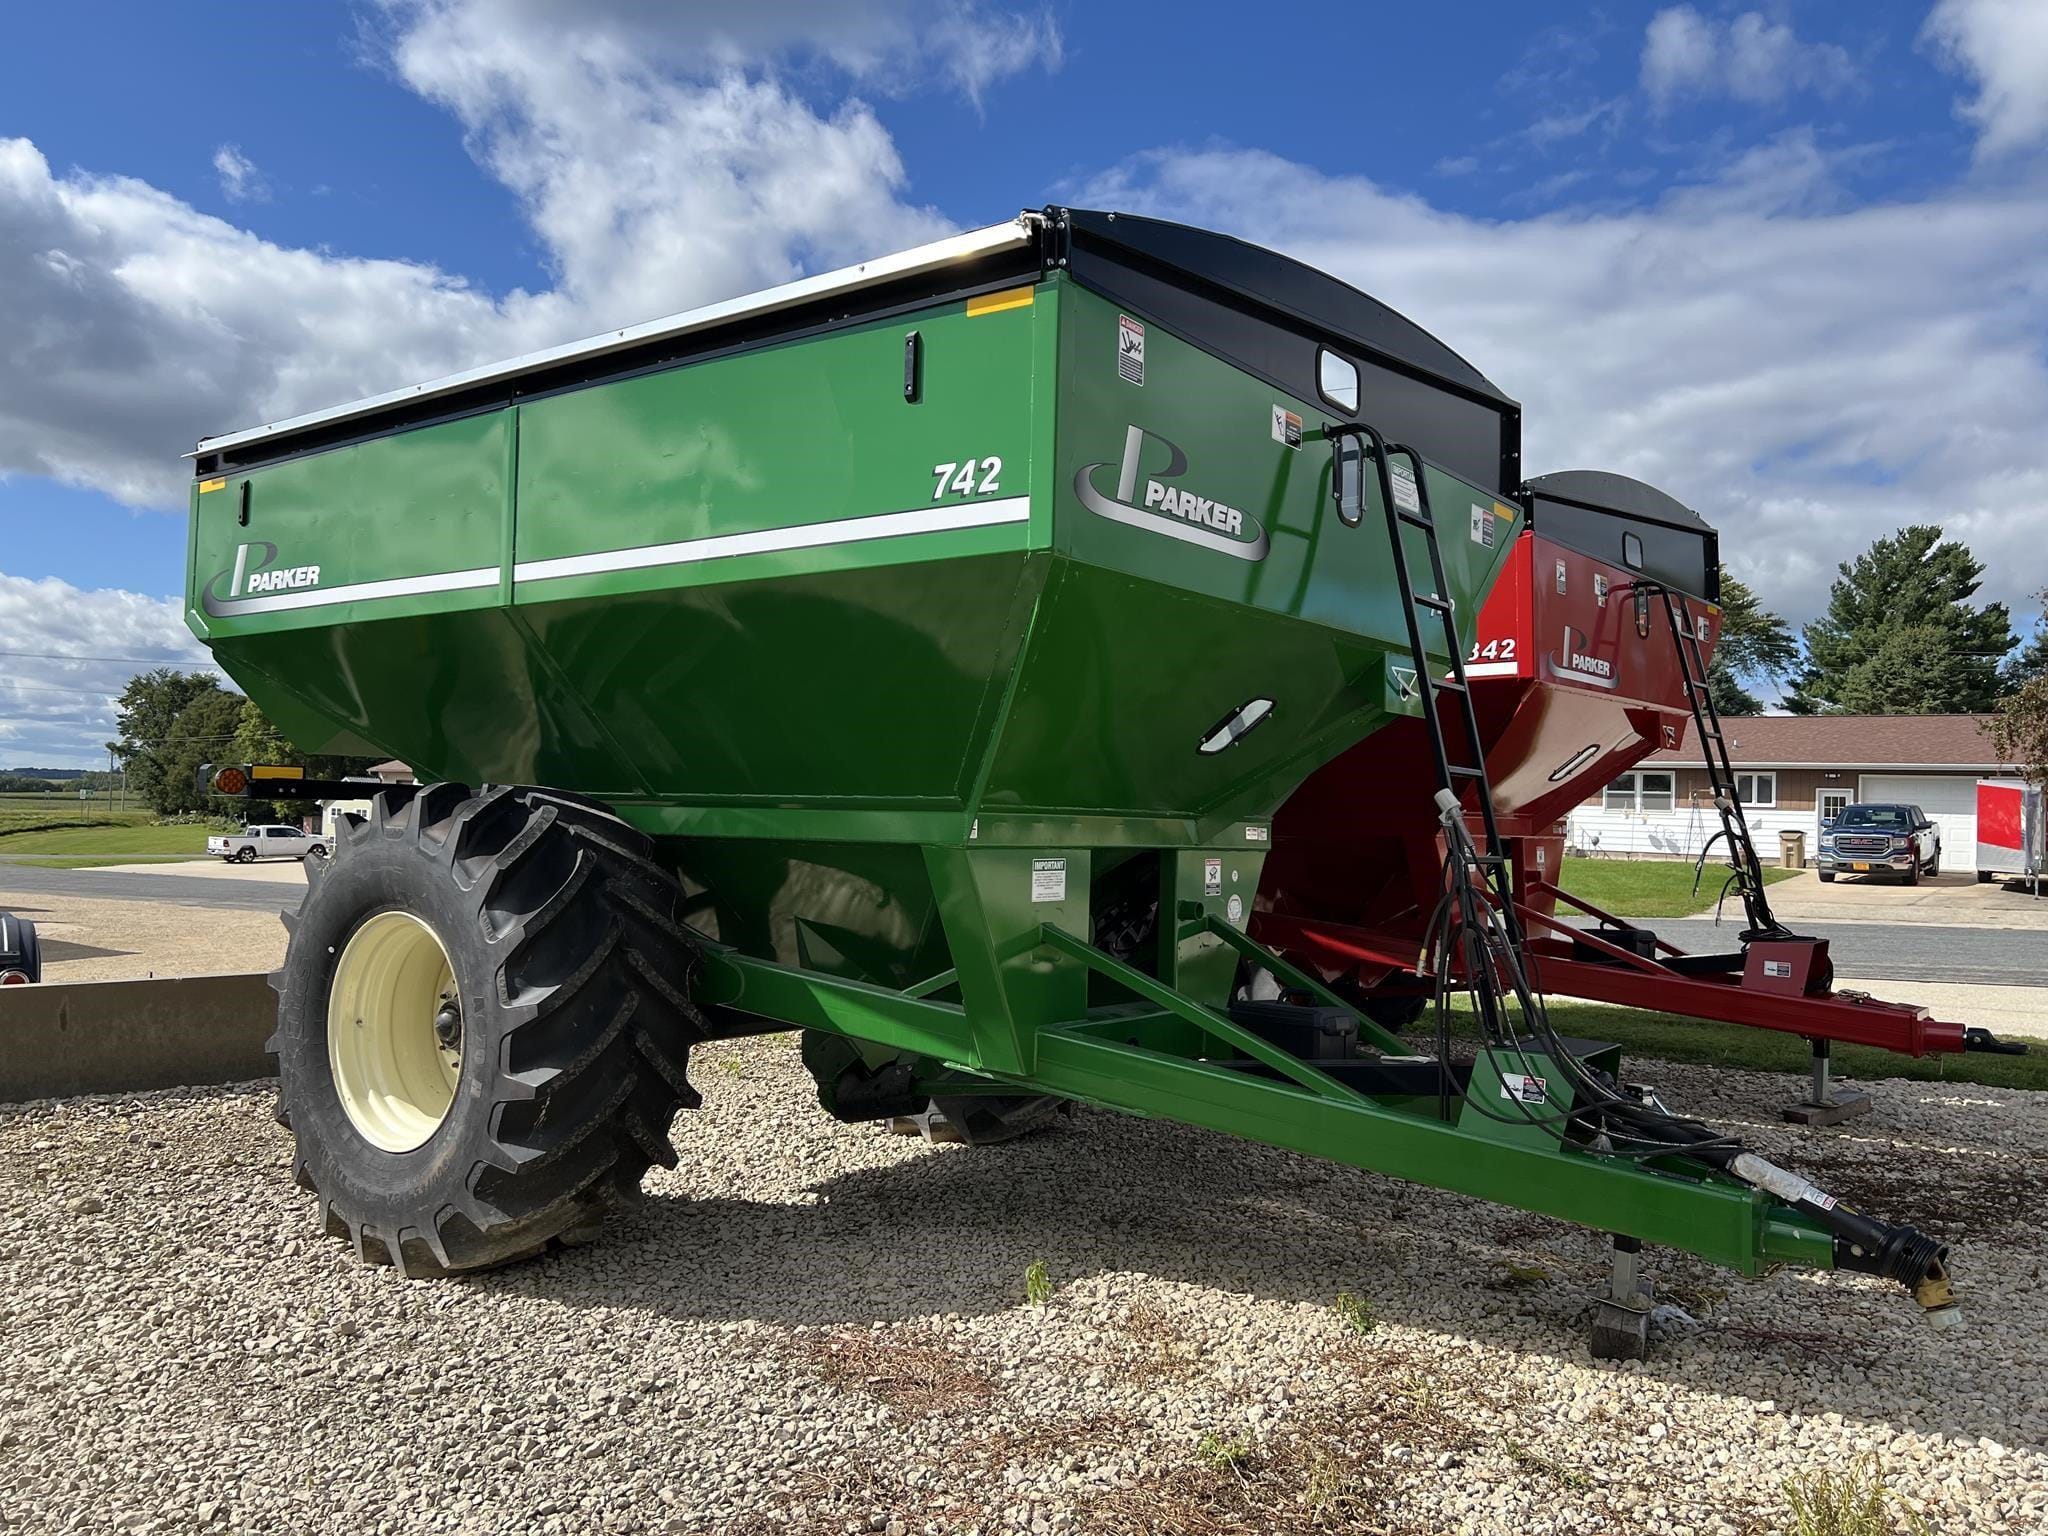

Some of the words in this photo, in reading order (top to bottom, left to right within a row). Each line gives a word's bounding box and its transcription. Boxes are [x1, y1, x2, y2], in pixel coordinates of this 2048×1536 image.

[933, 456, 1002, 499] 742
[1145, 480, 1242, 535] PARKER
[248, 566, 320, 592] PARKER
[1572, 653, 1610, 677] PARKER
[1034, 861, 1064, 870] IMPORTANT
